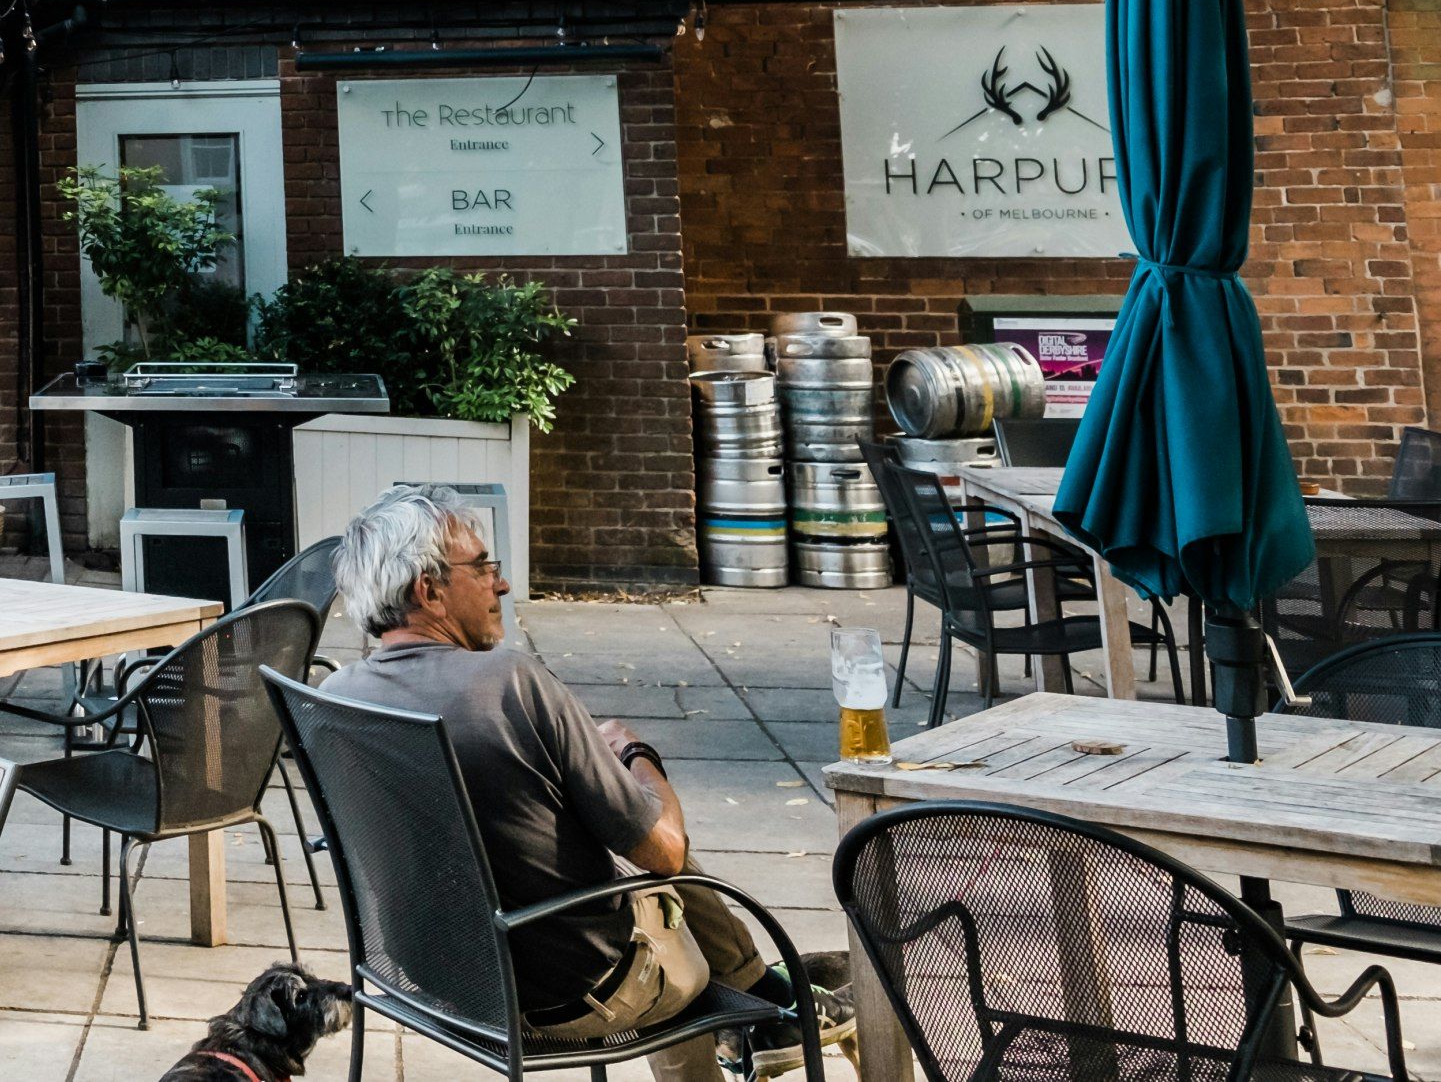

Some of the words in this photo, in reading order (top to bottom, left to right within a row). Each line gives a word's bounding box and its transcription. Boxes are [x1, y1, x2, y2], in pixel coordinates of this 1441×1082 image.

[381, 101, 428, 127] The
[438, 102, 577, 127] Restaurant
[450, 139, 510, 151] Entrance
[452, 190, 512, 211] BAR
[972, 209, 993, 219] OF
[999, 209, 1098, 220] MELBOURNE
[454, 224, 514, 236] Entrance
[1039, 335, 1067, 346] DIGITAL
[1039, 345, 1088, 356] DERBYSHIRE
